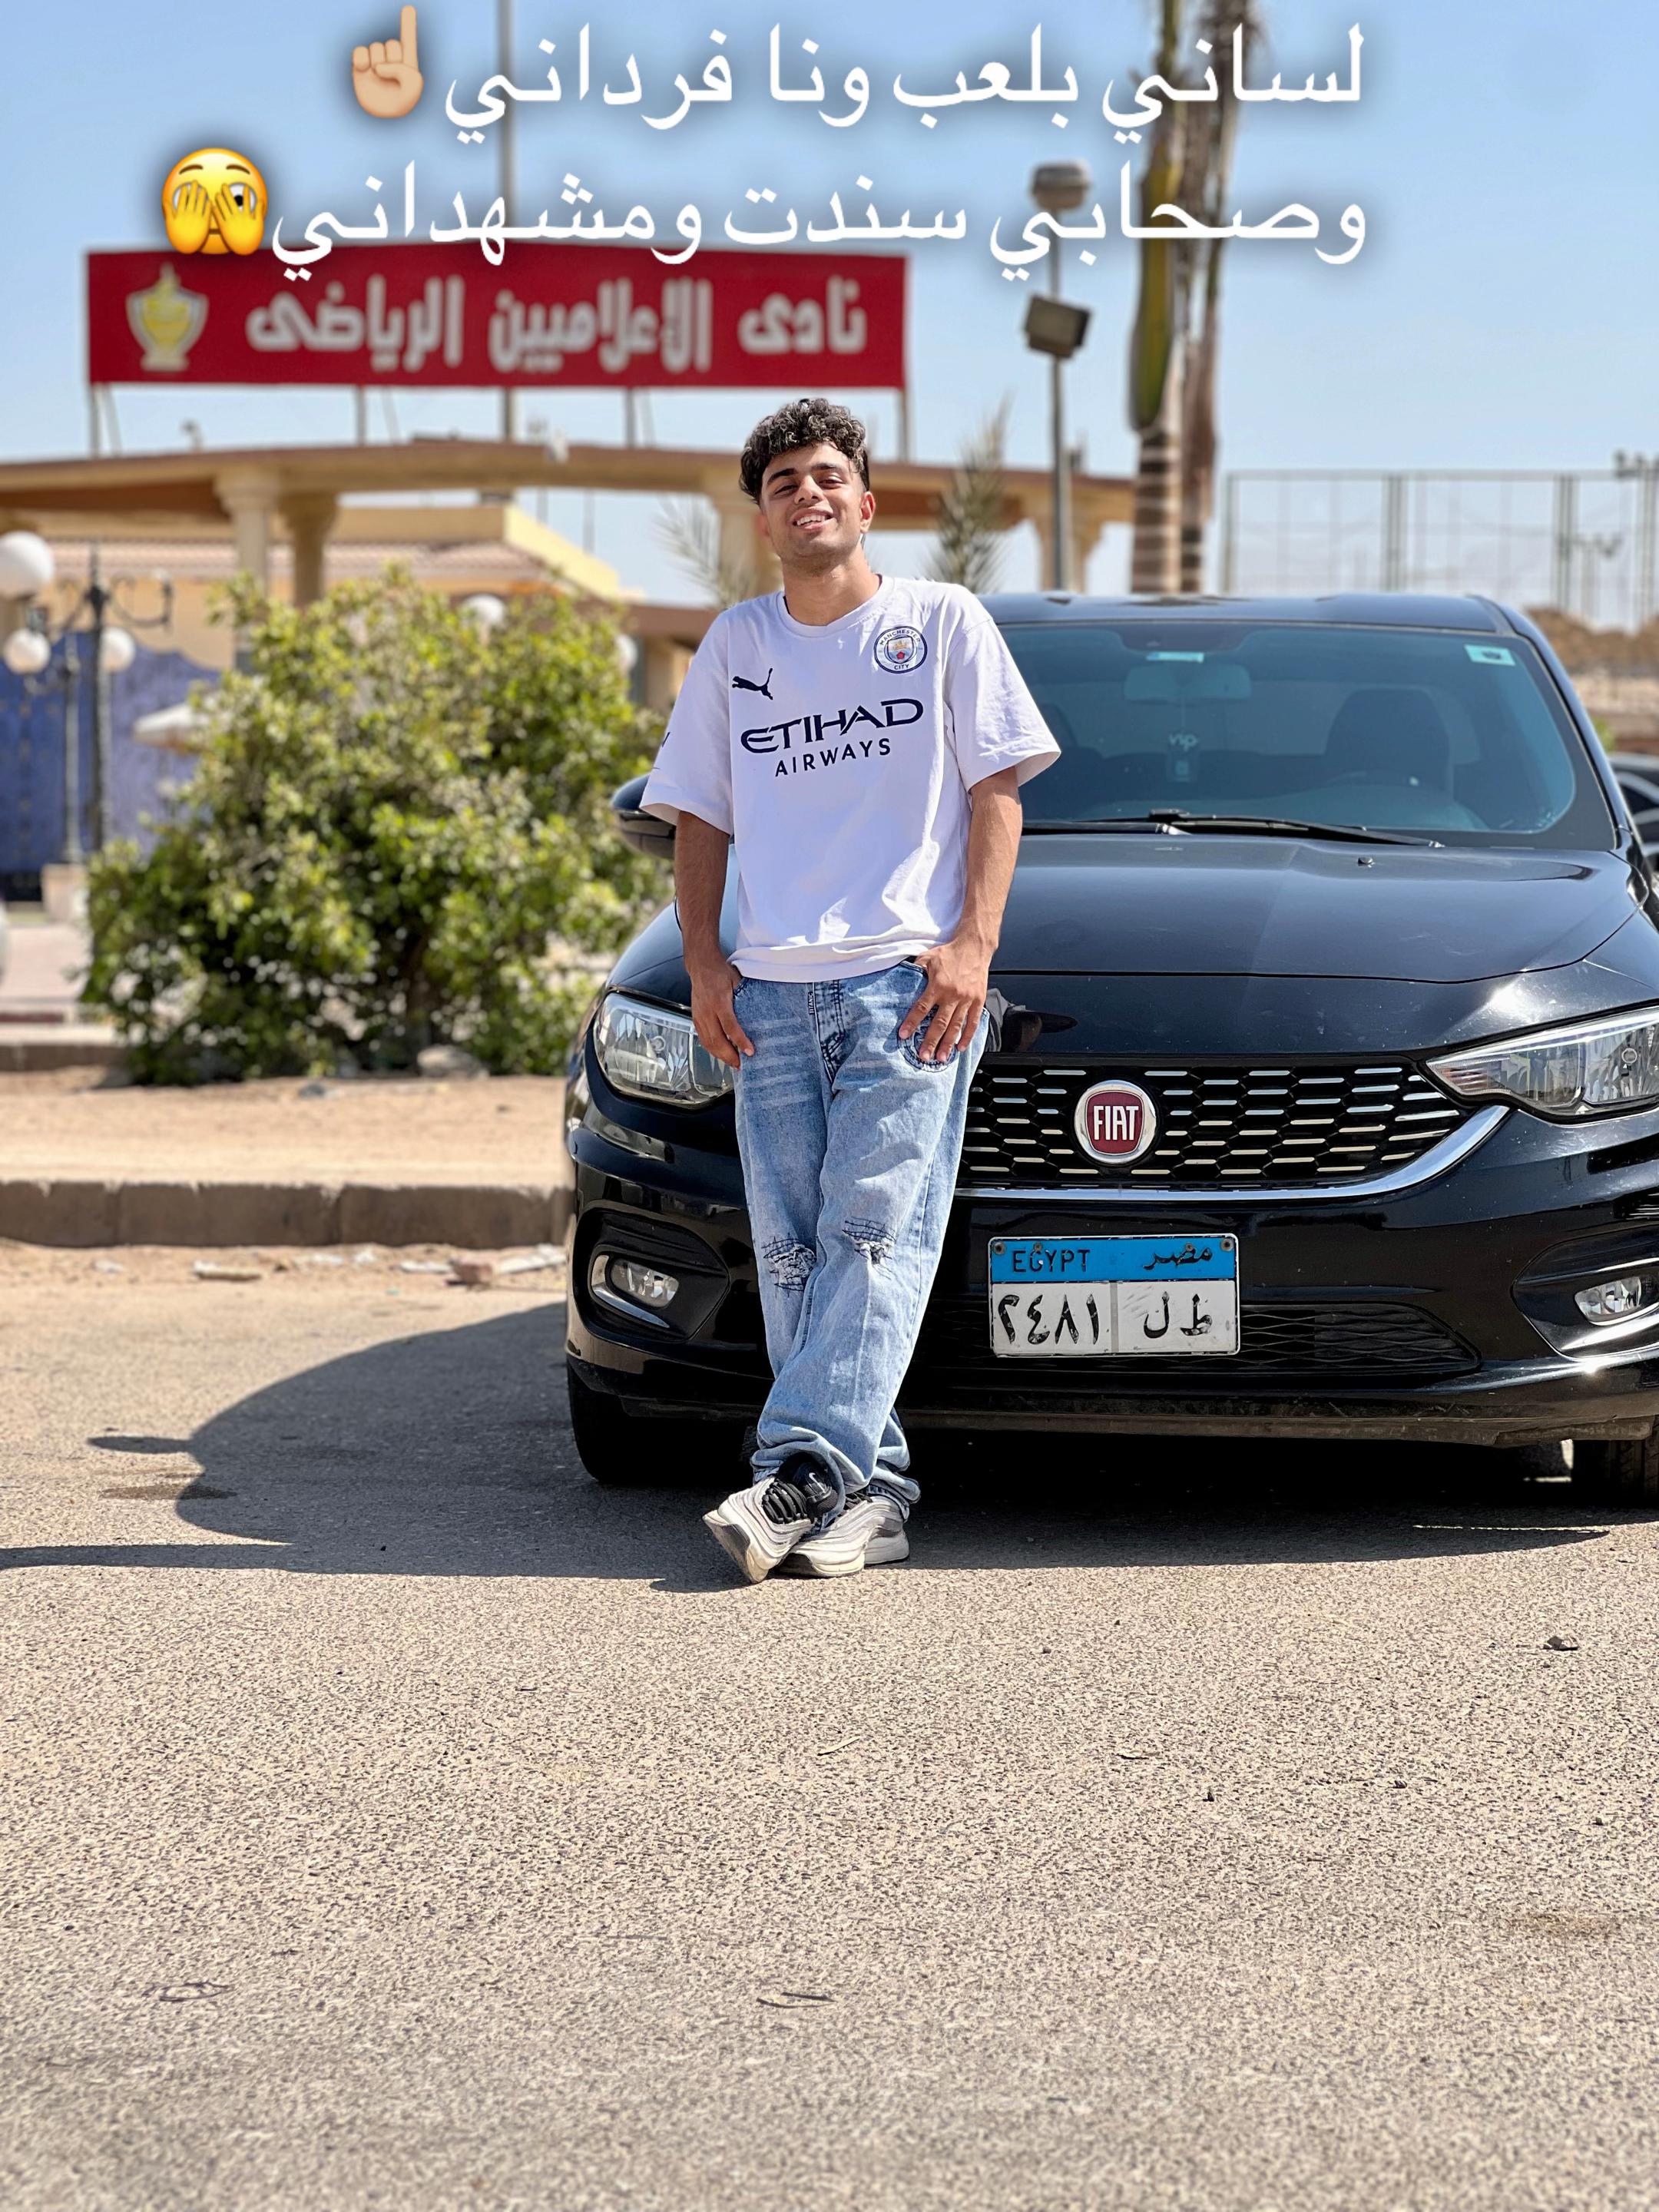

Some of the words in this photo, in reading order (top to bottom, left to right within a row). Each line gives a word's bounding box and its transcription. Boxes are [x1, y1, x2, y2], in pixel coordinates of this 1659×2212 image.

[879, 629, 921, 645] MANCHESTER
[740, 698, 924, 753] ETIHAD
[775, 738, 891, 777] AIRWAYS
[1093, 1105, 1139, 1141] FIAT
[1012, 1250, 1091, 1273] EGYPT
[1143, 1246, 1213, 1271] مصر
